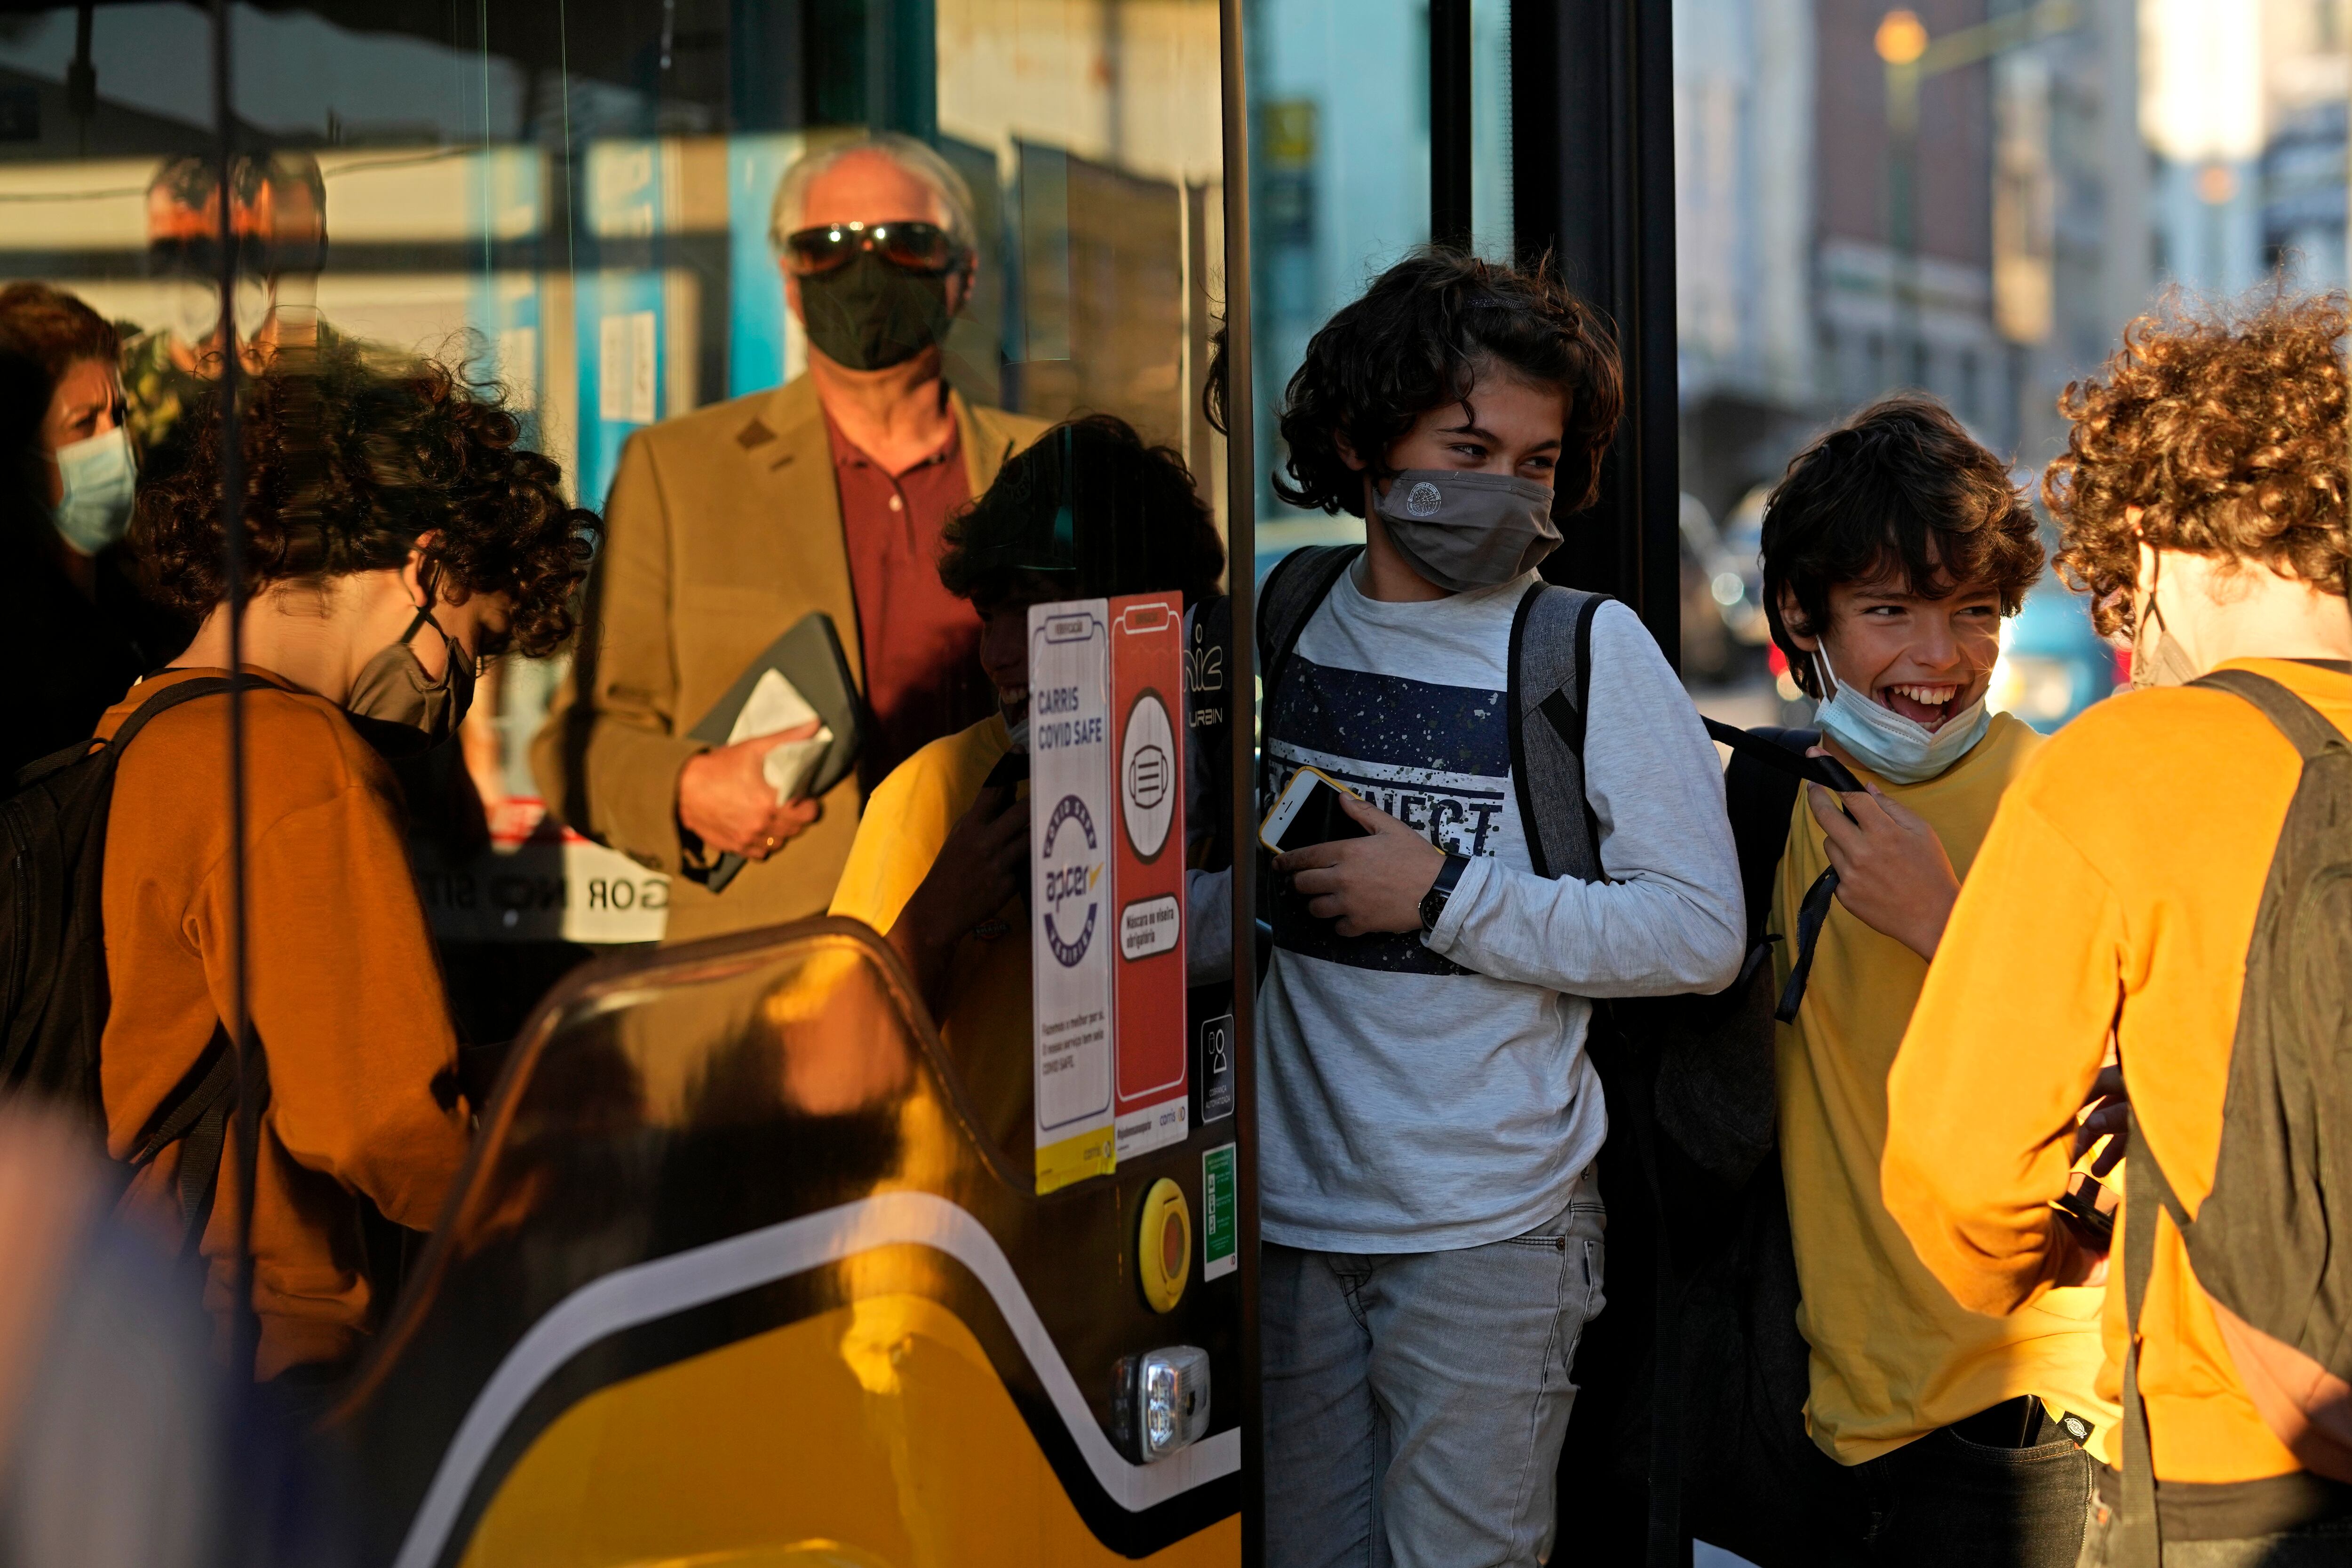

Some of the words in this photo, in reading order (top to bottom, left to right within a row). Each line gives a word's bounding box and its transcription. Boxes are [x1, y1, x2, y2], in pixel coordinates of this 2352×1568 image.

[1038, 687, 1079, 715] CARRIS
[1038, 721, 1071, 750] COVID
[1075, 717, 1101, 745] SAFE
[1046, 865, 1089, 914] apcer
